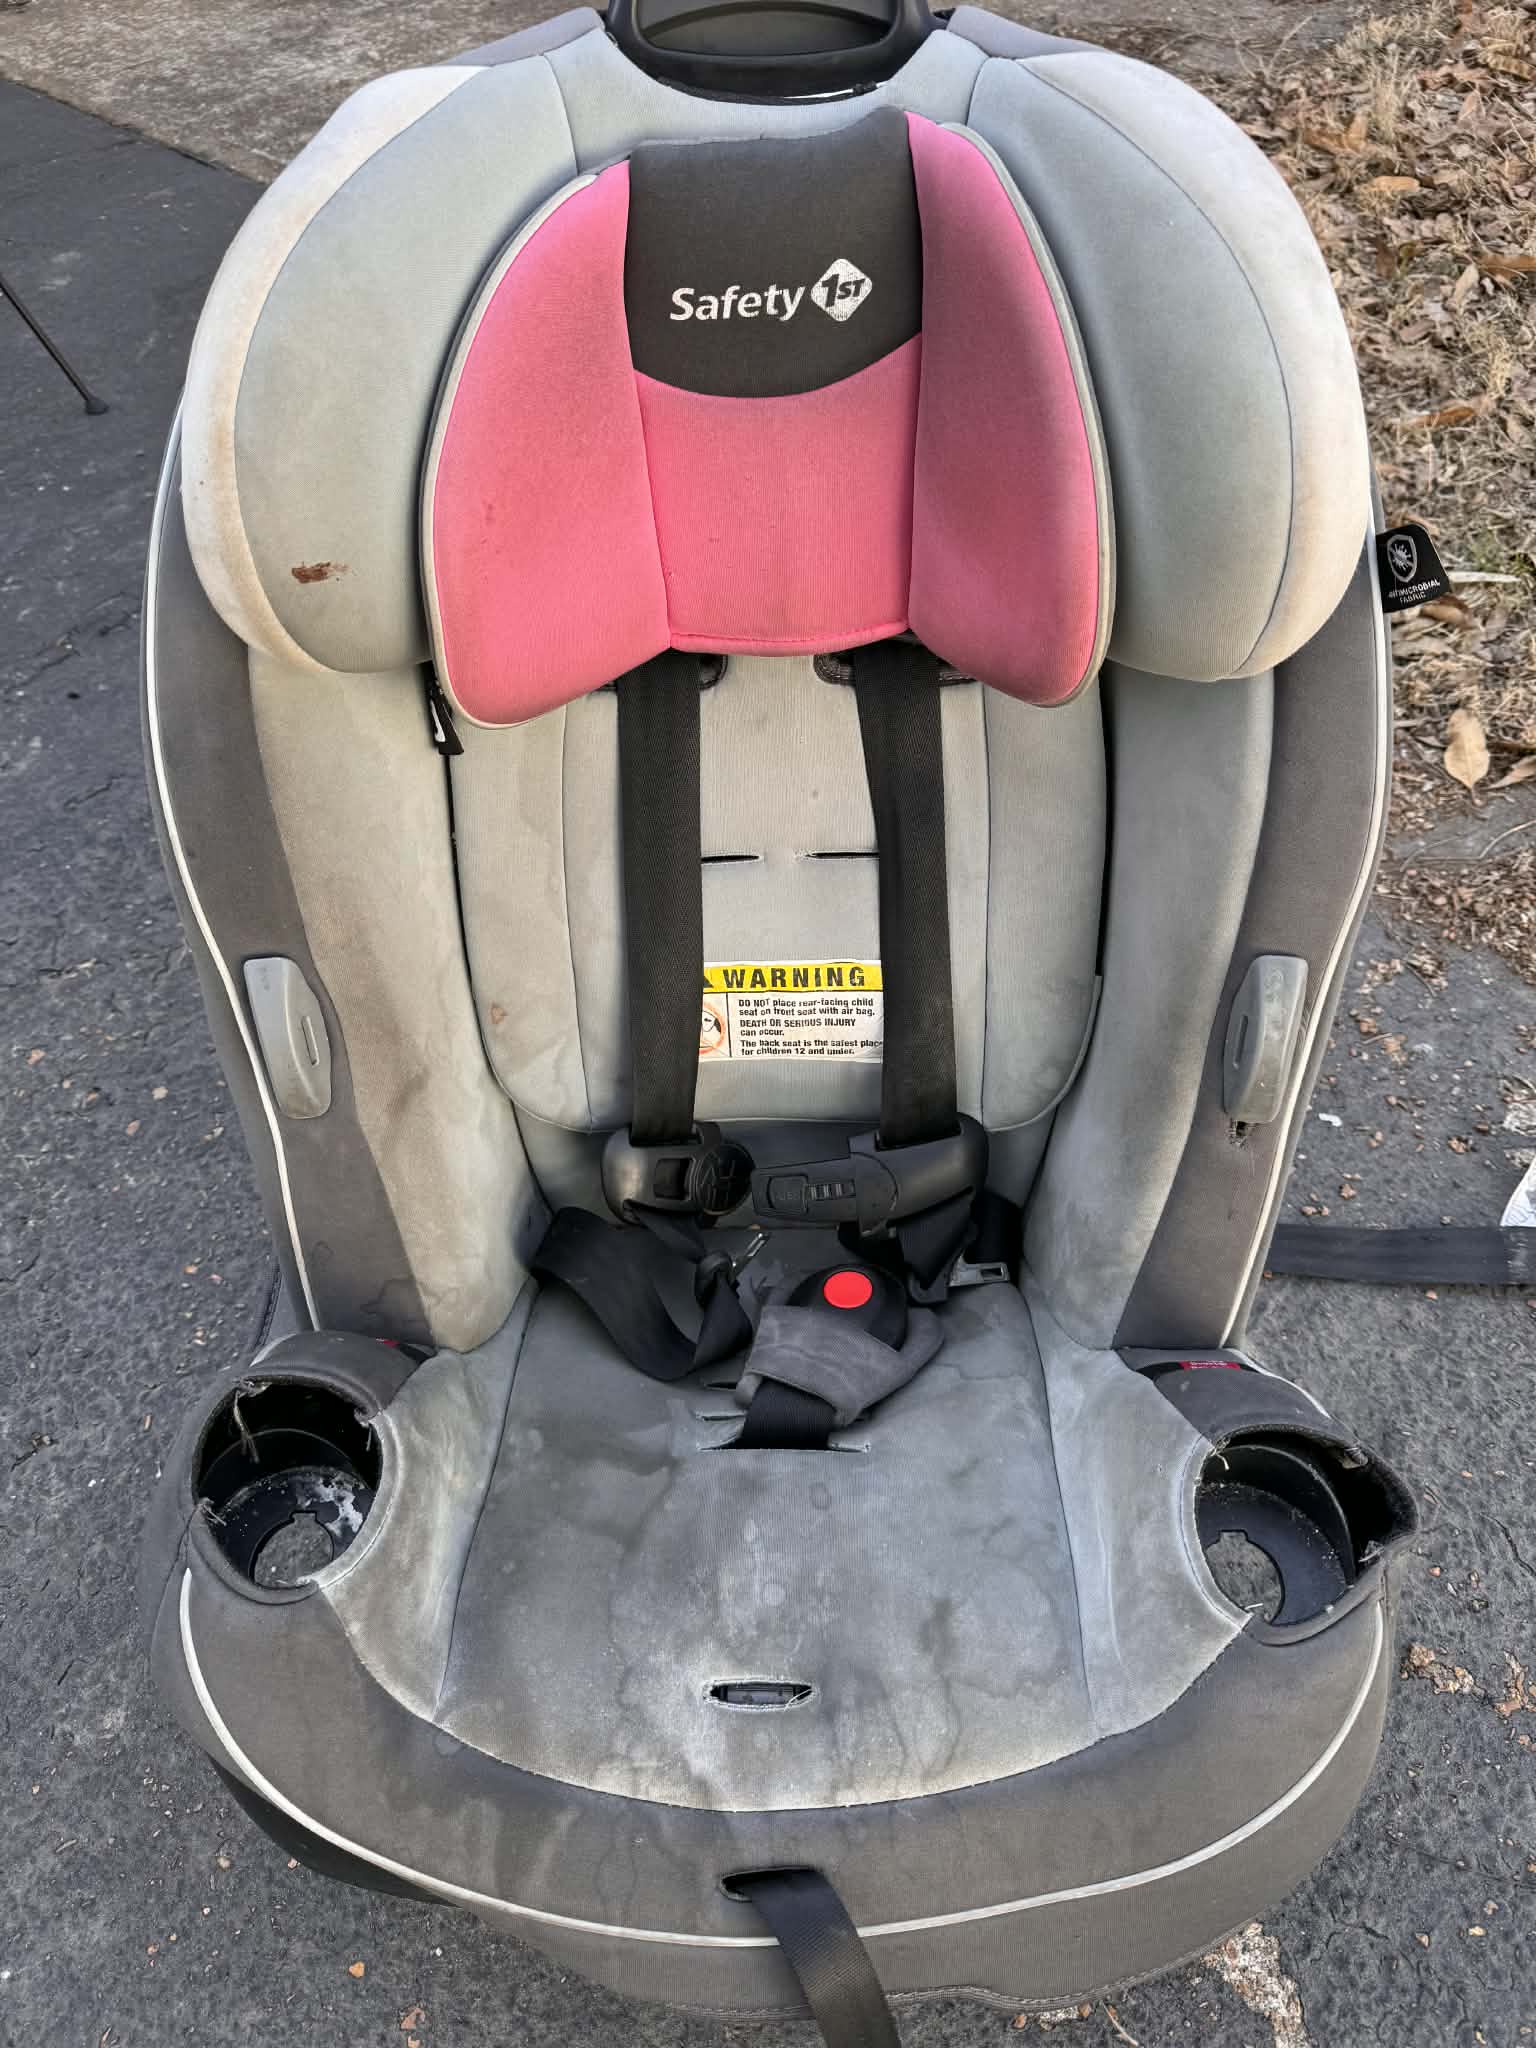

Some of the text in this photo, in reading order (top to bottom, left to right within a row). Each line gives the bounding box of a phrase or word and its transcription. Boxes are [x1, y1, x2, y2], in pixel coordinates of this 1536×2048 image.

[669, 284, 806, 321] Safety
[723, 966, 865, 989] WARNING
[753, 998, 770, 1007] NOT
[772, 998, 797, 1007] place
[798, 998, 849, 1008] rear-facing
[851, 998, 874, 1006] child
[739, 1008, 758, 1016] seat
[773, 1007, 795, 1016] front
[797, 1008, 817, 1016] seat
[841, 1007, 854, 1015] air
[855, 1008, 875, 1016] bag.
[740, 1018, 856, 1028] DEATH OR SERIOUS INJURY
[740, 1029, 757, 1037] can
[759, 1039, 780, 1047] back
[814, 1039, 829, 1047] the
[741, 1048, 755, 1056] for
[756, 1046, 792, 1055] children
[808, 1047, 825, 1055] and
[827, 1048, 855, 1056] under.
